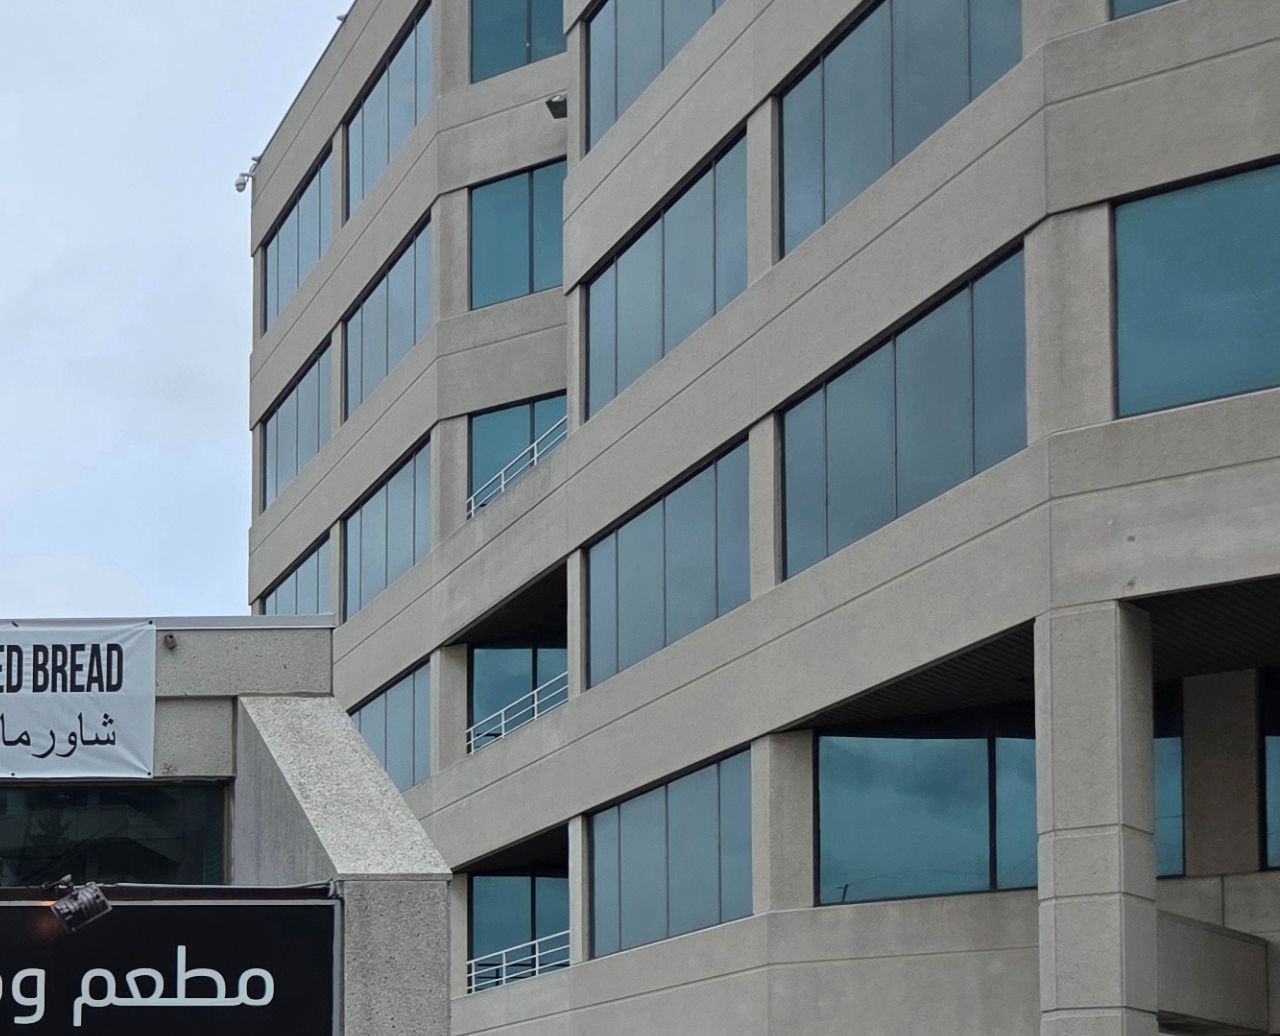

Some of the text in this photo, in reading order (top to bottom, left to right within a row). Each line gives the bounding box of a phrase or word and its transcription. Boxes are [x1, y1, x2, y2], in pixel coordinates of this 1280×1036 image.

[33, 644, 125, 693] BREAD
[0, 713, 117, 759] شاورما
[73, 944, 276, 1027] مطعم
